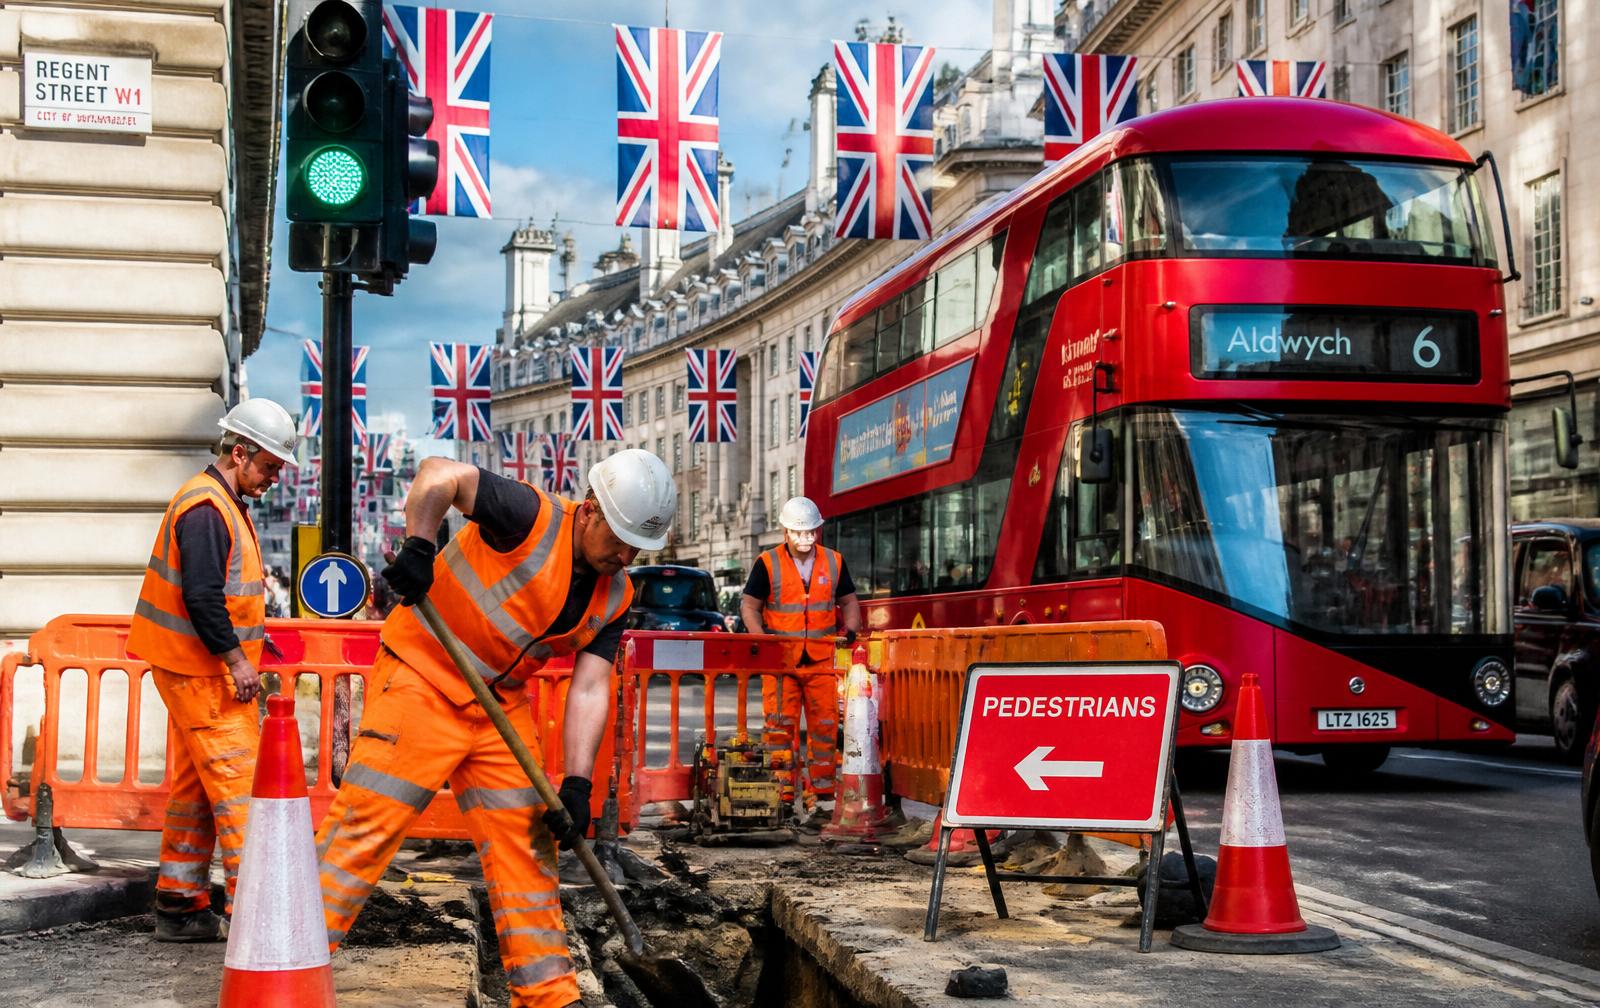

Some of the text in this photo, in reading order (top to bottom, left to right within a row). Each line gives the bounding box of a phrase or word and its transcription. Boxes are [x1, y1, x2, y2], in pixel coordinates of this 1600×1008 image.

[36, 60, 110, 81] REGENT
[35, 82, 141, 106] STREET W1
[1227, 326, 1352, 361] Aldwych
[1412, 325, 1441, 368] 6
[982, 696, 1156, 718] PEDESTRIANS
[1325, 712, 1389, 727] LTZ 1625
